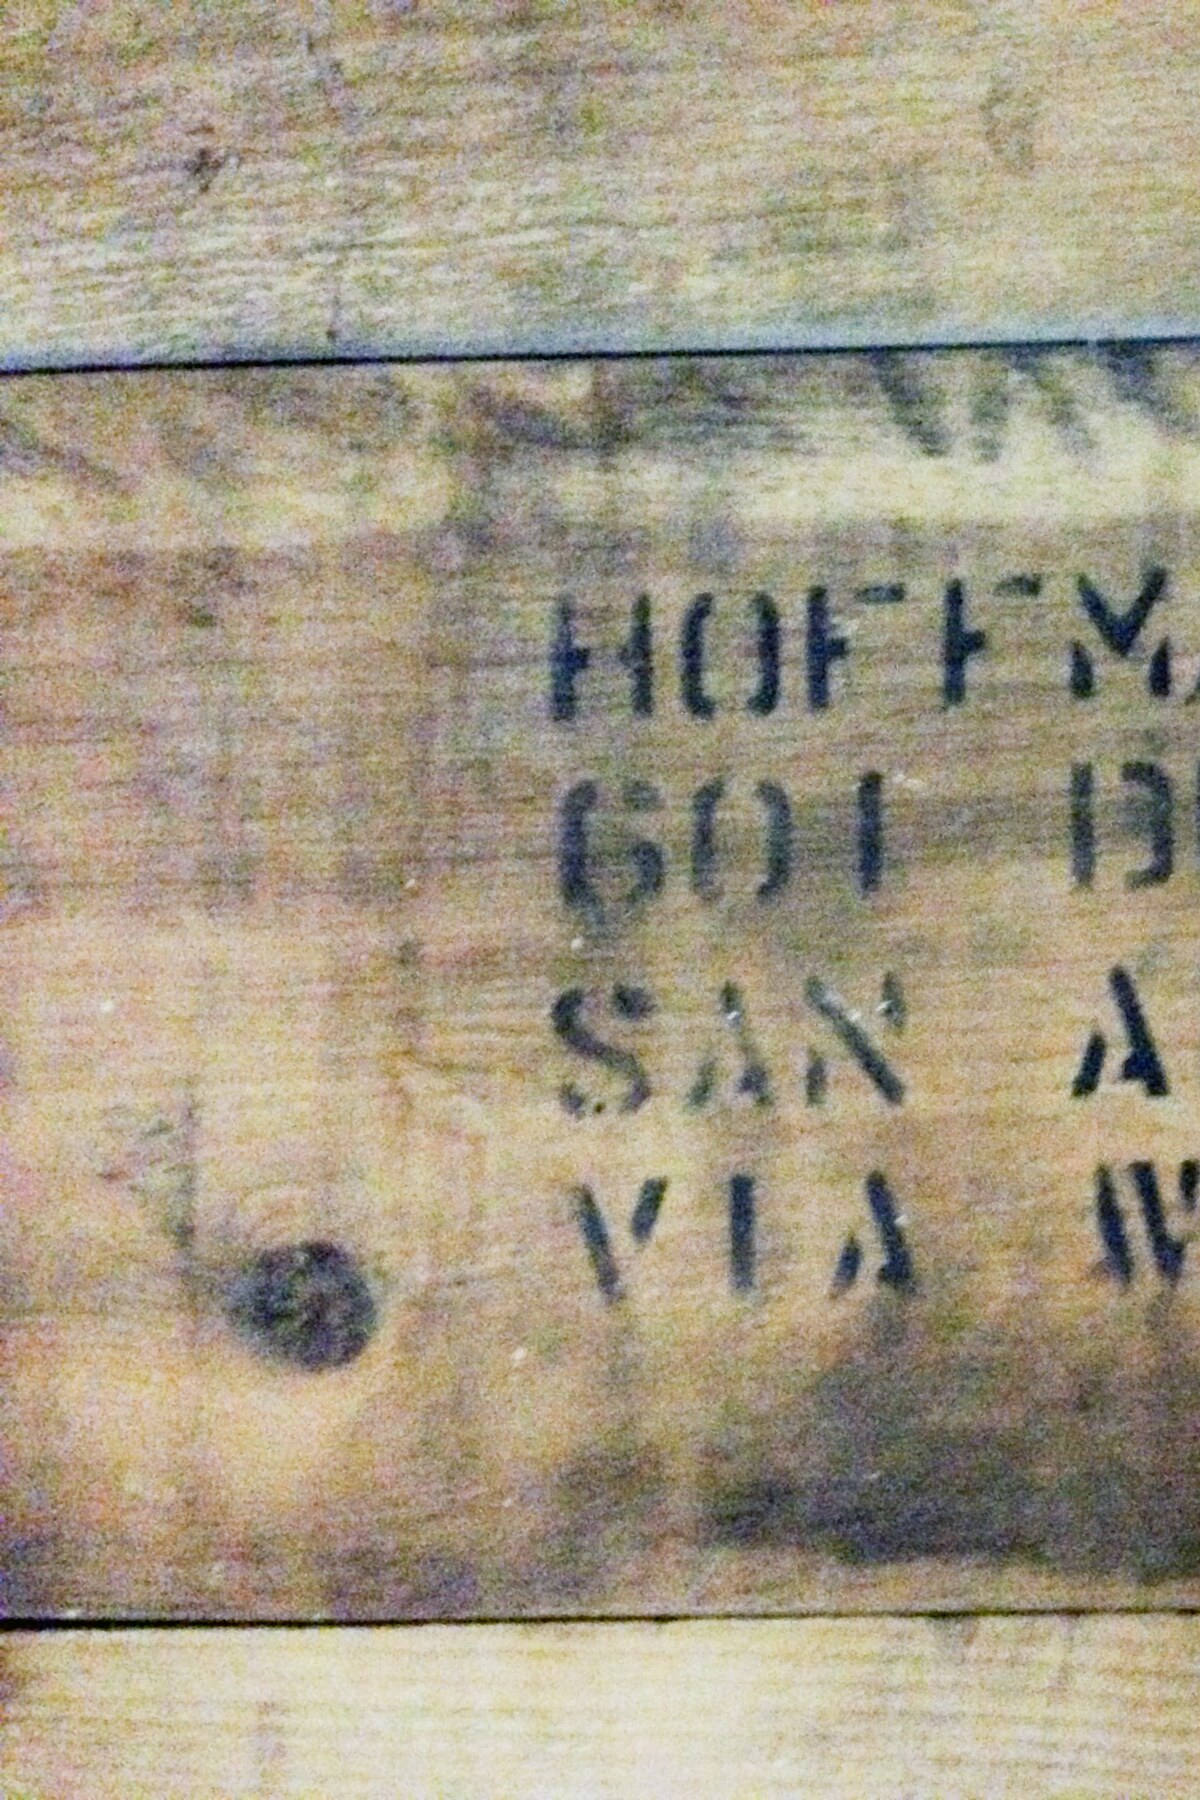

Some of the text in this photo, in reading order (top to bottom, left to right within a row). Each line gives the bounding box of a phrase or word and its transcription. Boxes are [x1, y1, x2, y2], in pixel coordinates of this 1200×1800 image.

[558, 769, 886, 908] 601
[550, 970, 906, 1120] SAN
[570, 1166, 918, 1304] VIA
